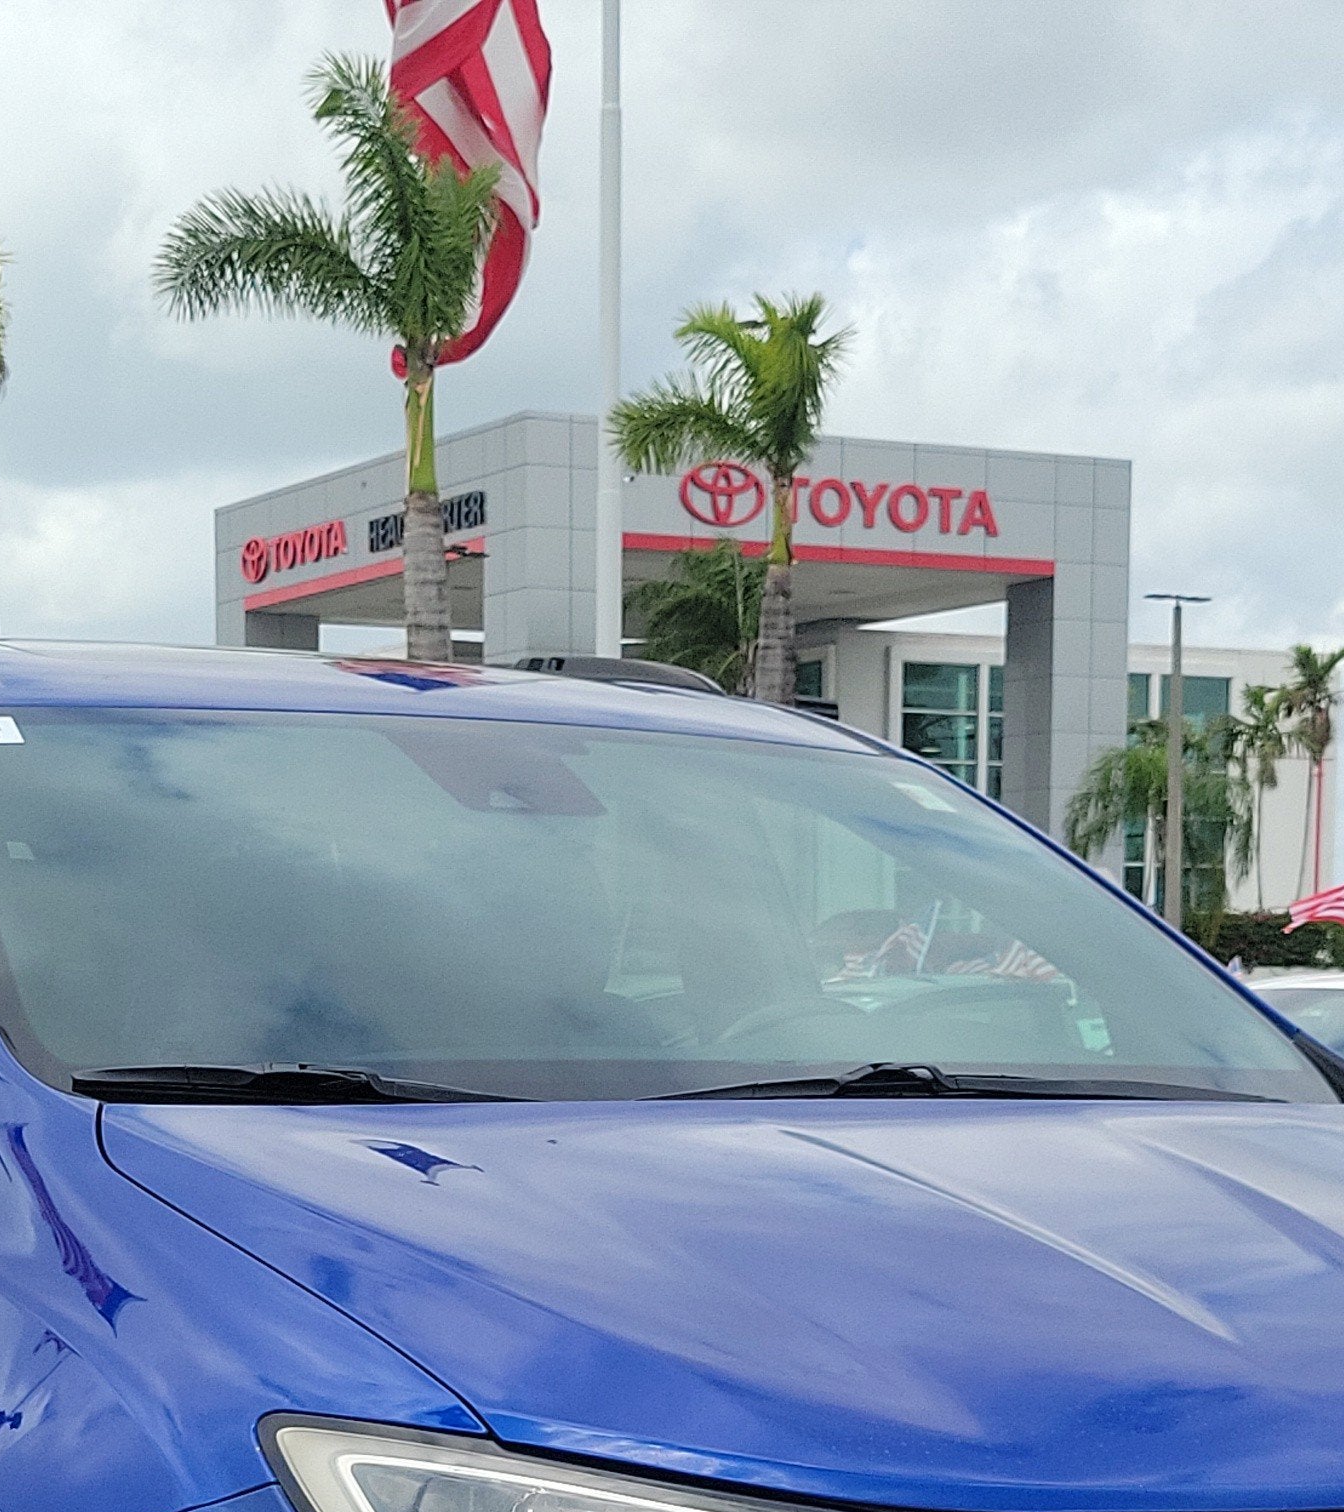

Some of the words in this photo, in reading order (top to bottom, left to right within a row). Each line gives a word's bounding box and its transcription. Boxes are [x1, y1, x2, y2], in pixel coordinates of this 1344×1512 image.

[269, 520, 348, 572] TOYOTA
[369, 491, 486, 553] HEARTER
[791, 476, 999, 538] TOYOTA
